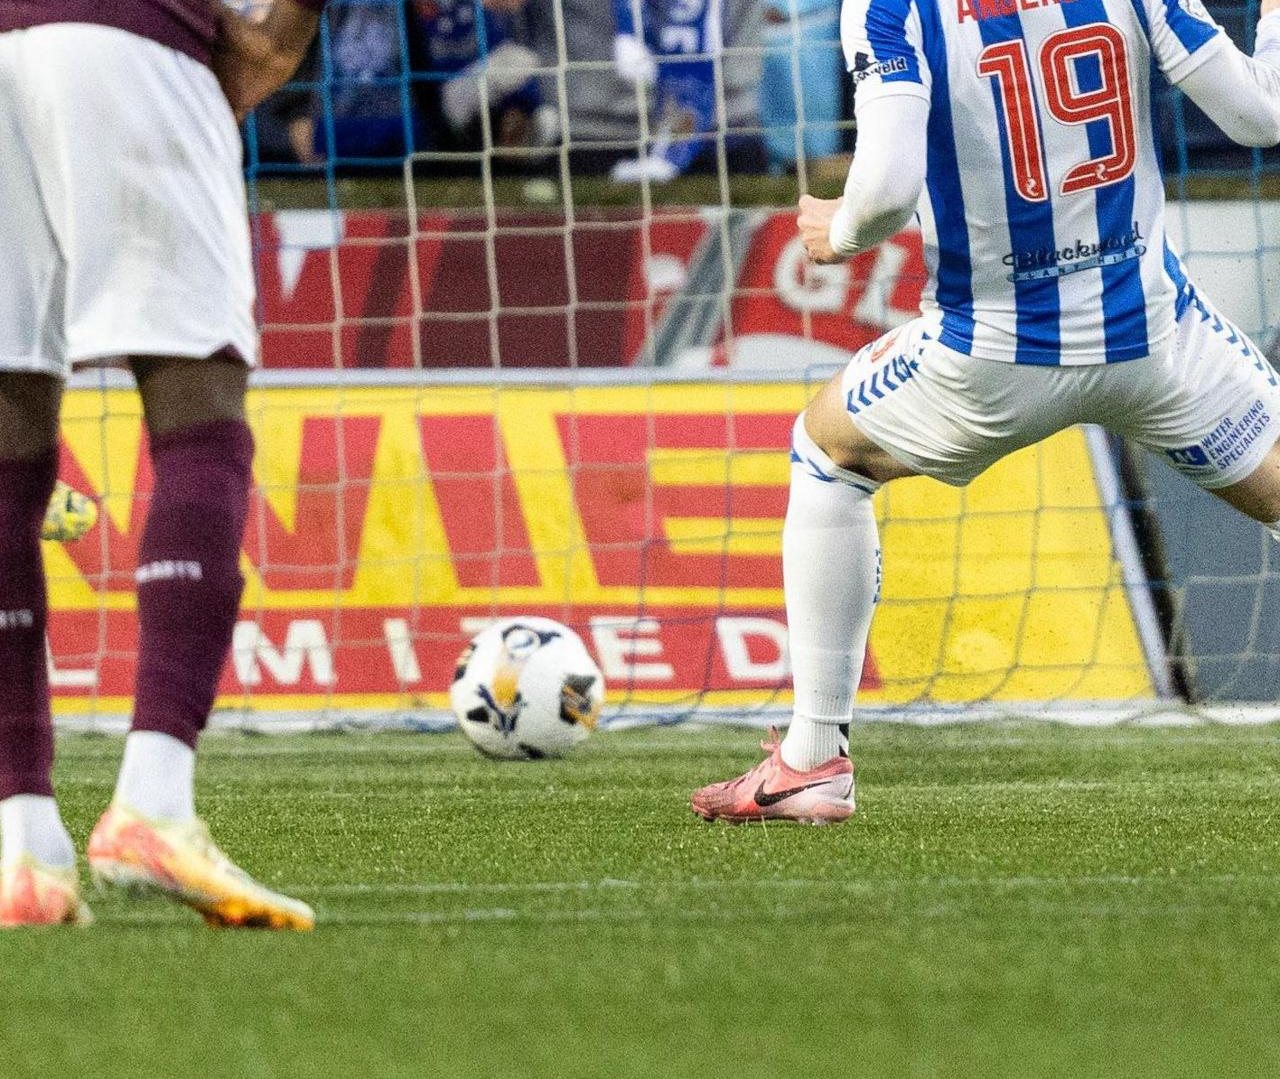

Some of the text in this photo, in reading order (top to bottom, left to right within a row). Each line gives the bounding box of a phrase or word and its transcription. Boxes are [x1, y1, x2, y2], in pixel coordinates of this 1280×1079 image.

[976, 22, 1139, 203] 19
[1002, 220, 1144, 270] Blackwood
[1201, 417, 1234, 450] WATER
[1208, 399, 1265, 461] ENGINEERING
[1217, 413, 1271, 471] SPECIALISTS
[43, 618, 798, 693] LMIED
